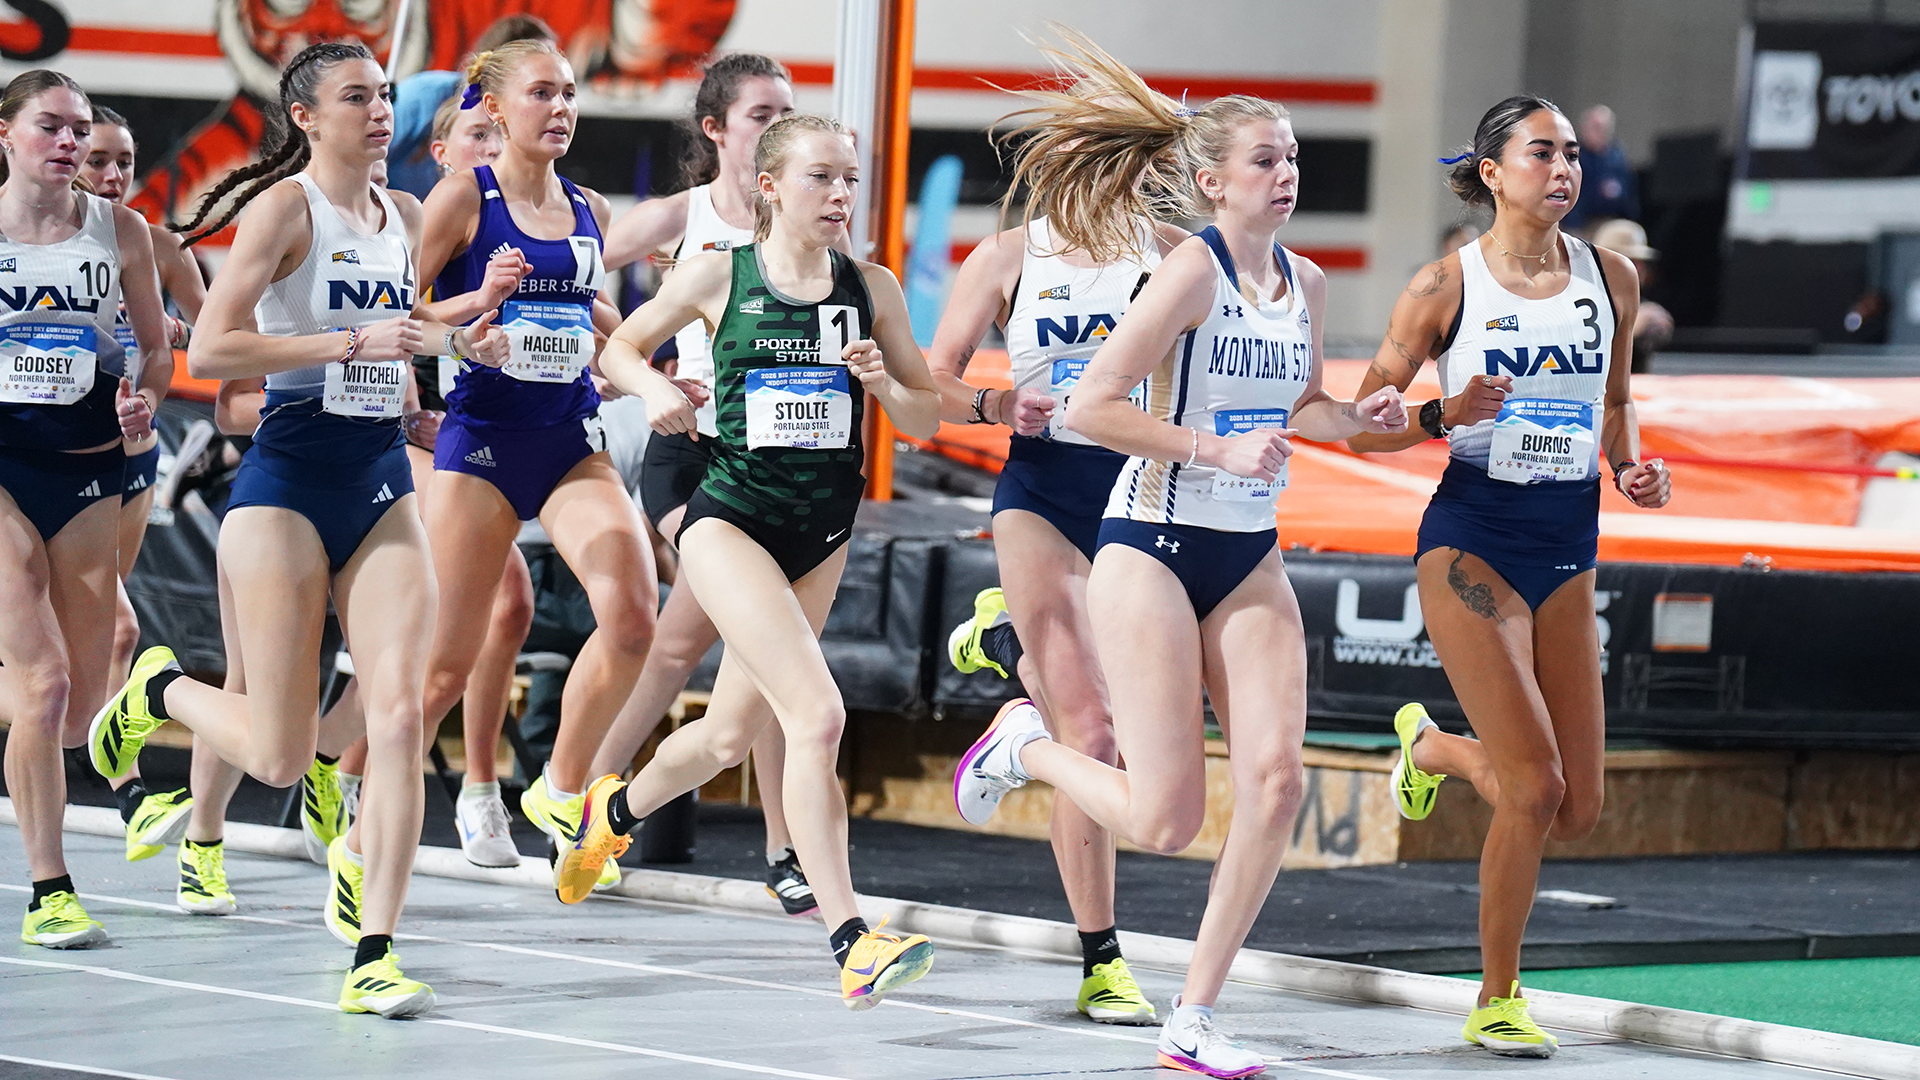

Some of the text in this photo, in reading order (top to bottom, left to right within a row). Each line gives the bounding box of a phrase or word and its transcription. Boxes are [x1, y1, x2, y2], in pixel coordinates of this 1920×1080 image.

[577, 240, 596, 286] 7
[79, 261, 110, 298] 10
[1035, 313, 1124, 348] NA
[1573, 298, 1602, 351] 3
[523, 335, 579, 355] HAGELIN
[830, 309, 849, 361] 1
[14, 355, 73, 375] GODSEY
[531, 354, 571, 364] WEBER STATE
[1208, 335, 1287, 380] MONTANA
[8, 374, 76, 385] NORTHERN ARIZONA
[342, 364, 400, 386] MITCHELL
[788, 377, 834, 385] CHAMPIONSHIPS
[803, 370, 838, 378] CONFERENCE
[344, 385, 396, 396] NORTHERN ARIZONA
[775, 401, 829, 421] STOLTE
[773, 421, 830, 431] PORTLAND STATE
[1521, 433, 1572, 455] BURNS
[464, 454, 497, 468] adidas
[1511, 451, 1575, 465] NORTHERN ARIZONA
